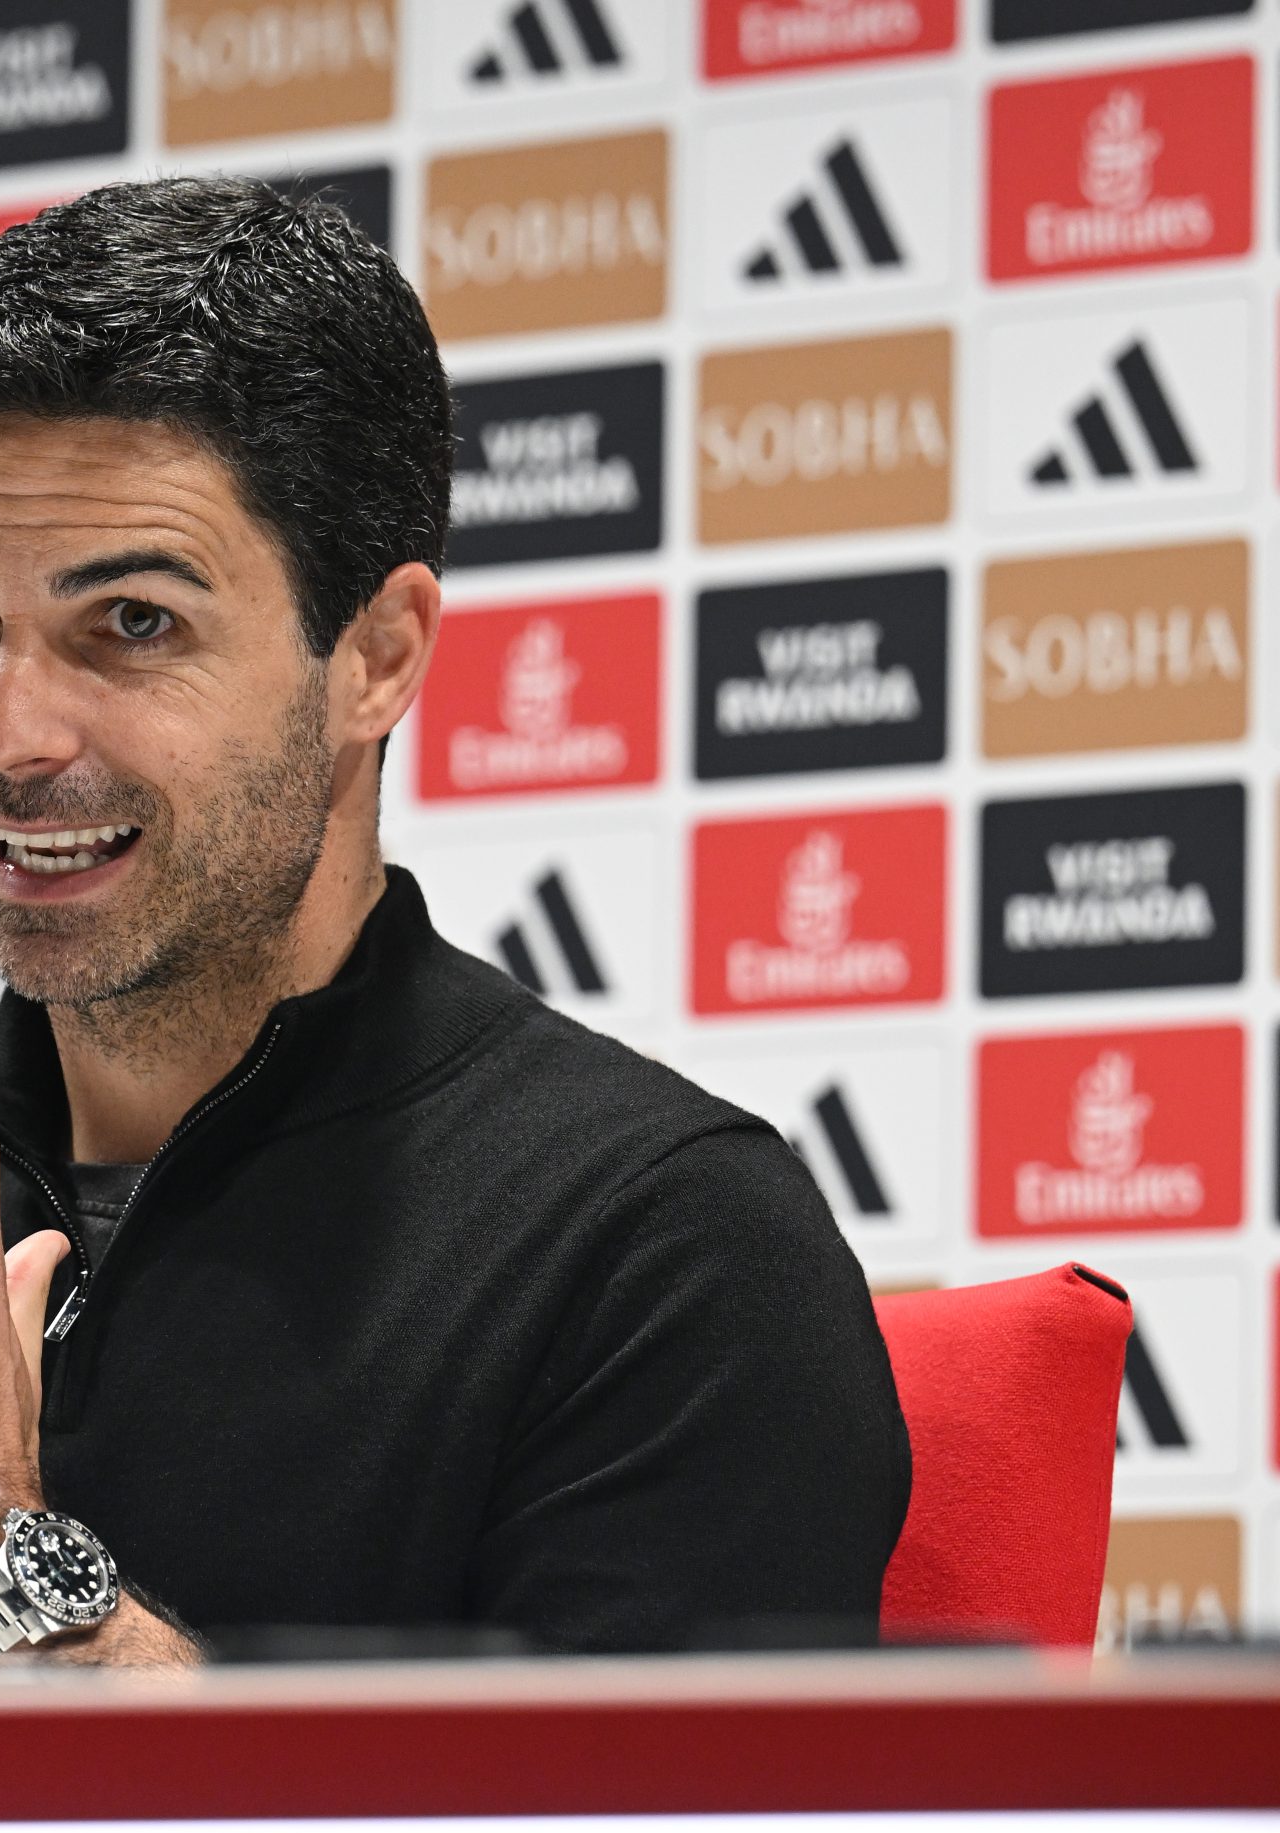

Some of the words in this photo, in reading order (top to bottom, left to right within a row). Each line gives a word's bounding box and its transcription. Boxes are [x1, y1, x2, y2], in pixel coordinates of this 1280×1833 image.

[1025, 194, 1214, 266] Emirates
[696, 395, 949, 489] SOBHA
[757, 619, 882, 677] VISIT
[983, 607, 1243, 702] SOBHA
[715, 666, 918, 736] RWANDA
[1044, 835, 1176, 892] VISIT
[1002, 883, 1214, 951] RWANDA
[1014, 1161, 1205, 1225] Emirates
